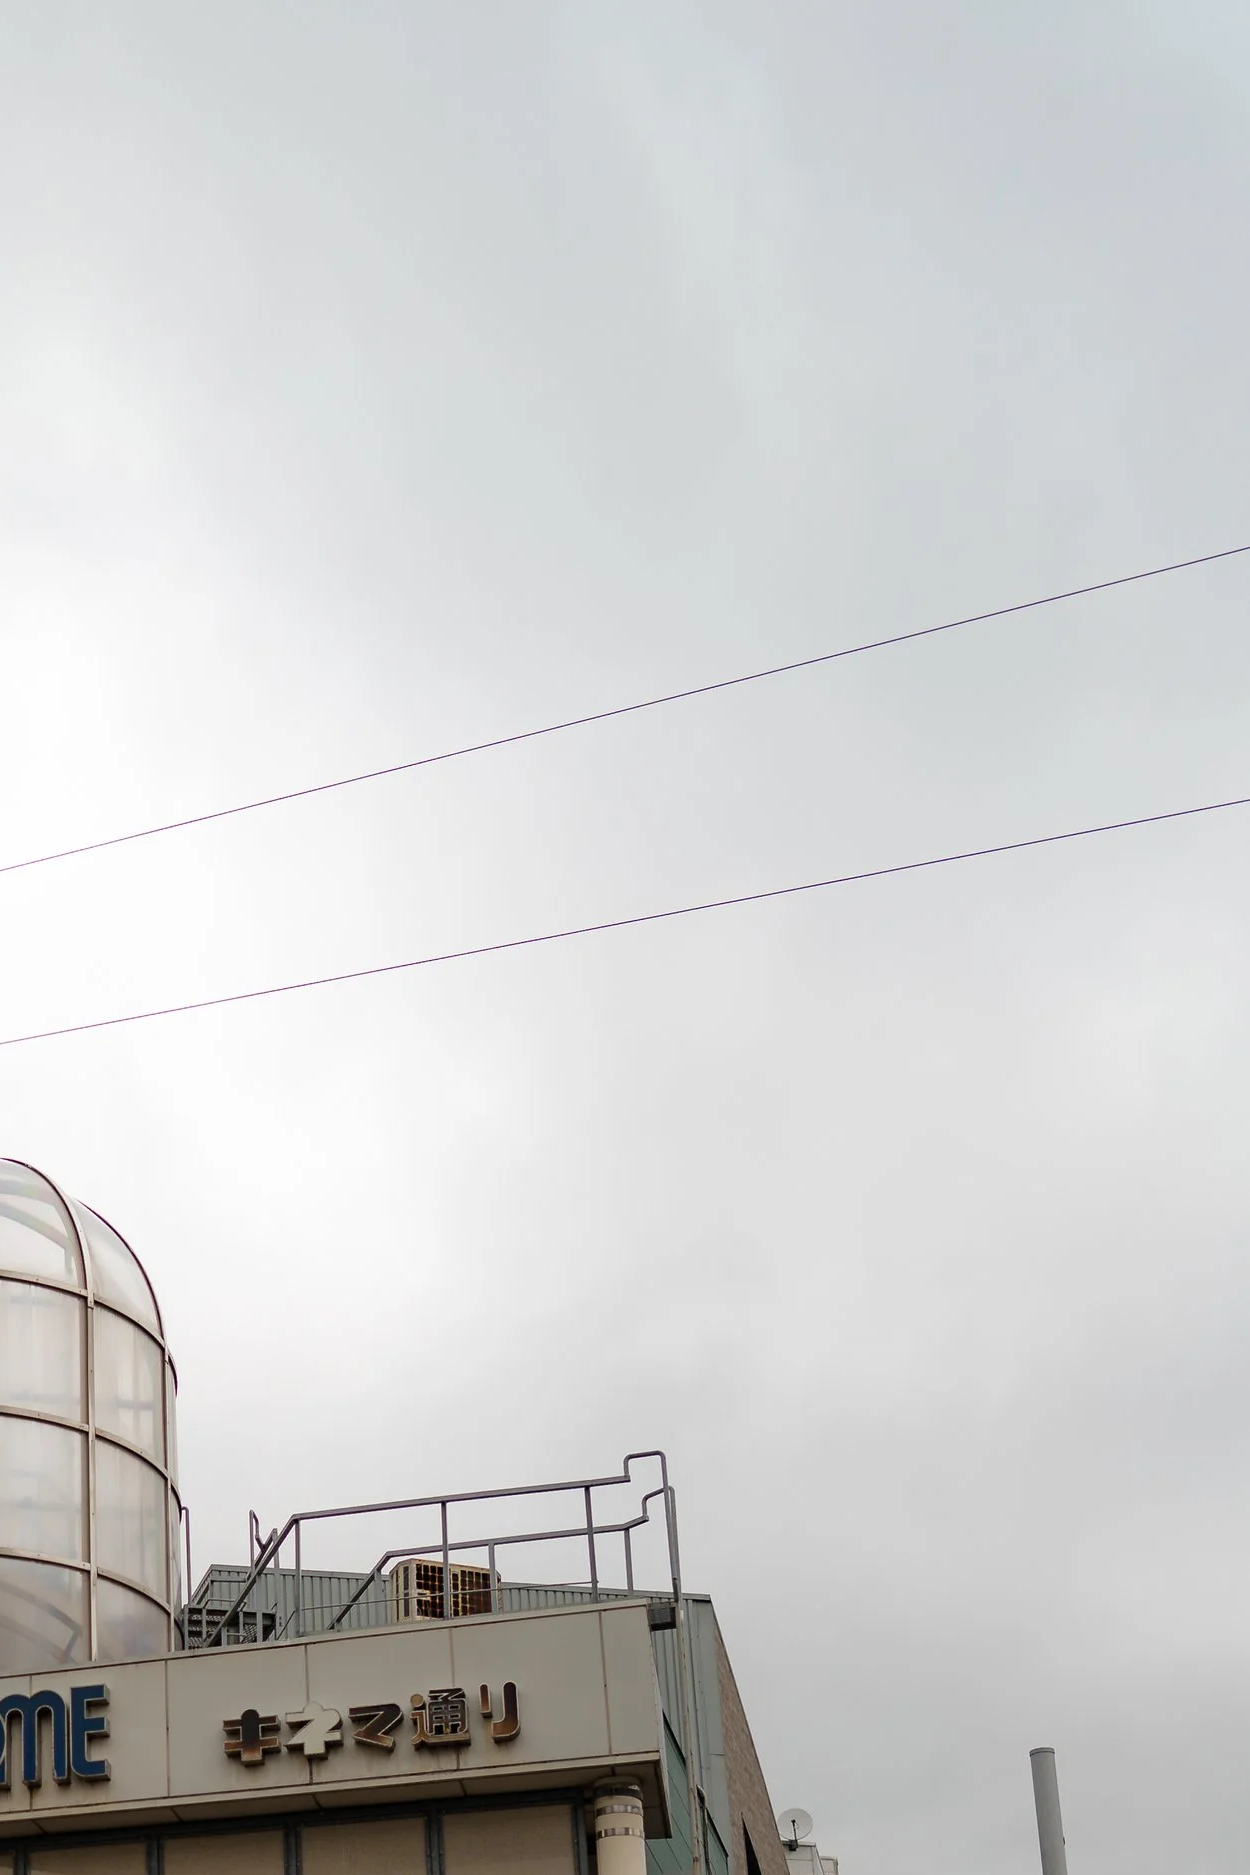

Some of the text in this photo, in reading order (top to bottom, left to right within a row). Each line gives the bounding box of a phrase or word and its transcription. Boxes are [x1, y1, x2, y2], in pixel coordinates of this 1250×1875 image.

[222, 1680, 521, 1767] キネマ通り
